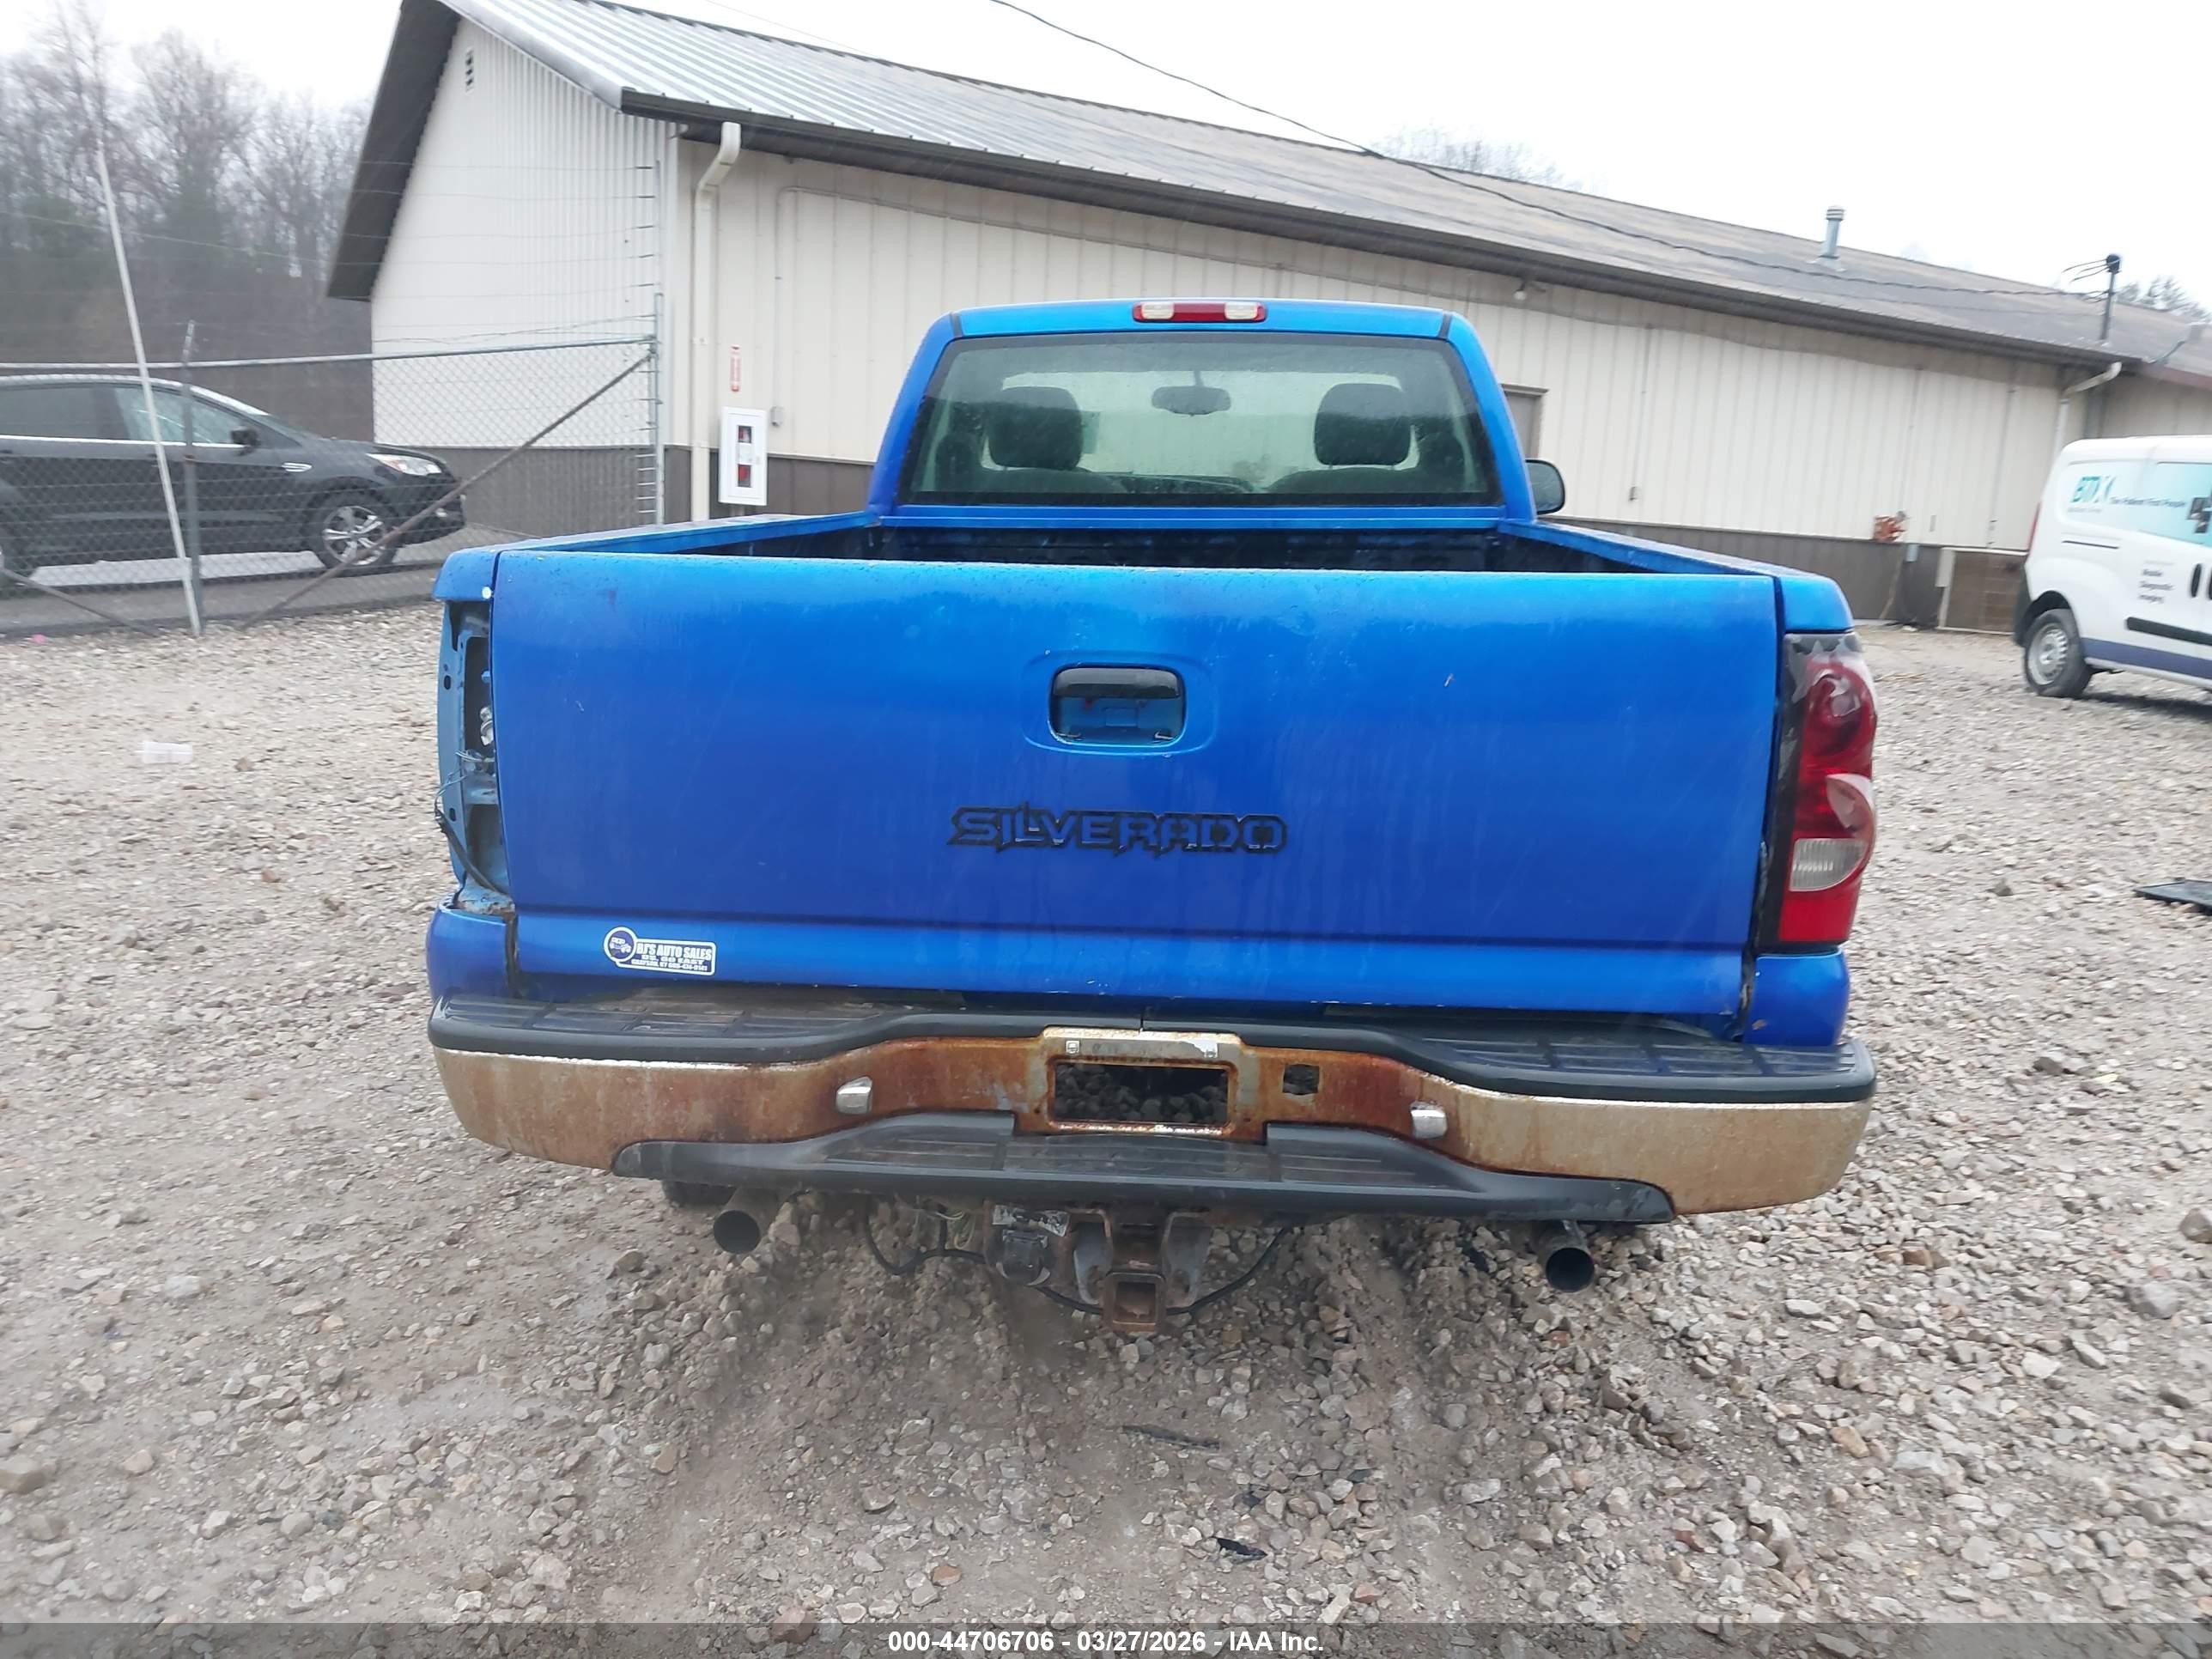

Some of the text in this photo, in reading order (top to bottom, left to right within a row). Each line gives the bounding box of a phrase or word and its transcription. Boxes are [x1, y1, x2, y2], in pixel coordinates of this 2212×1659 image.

[946, 802, 1287, 857] SILVERADO
[657, 945, 683, 958] AUTO
[684, 947, 712, 960] SALES
